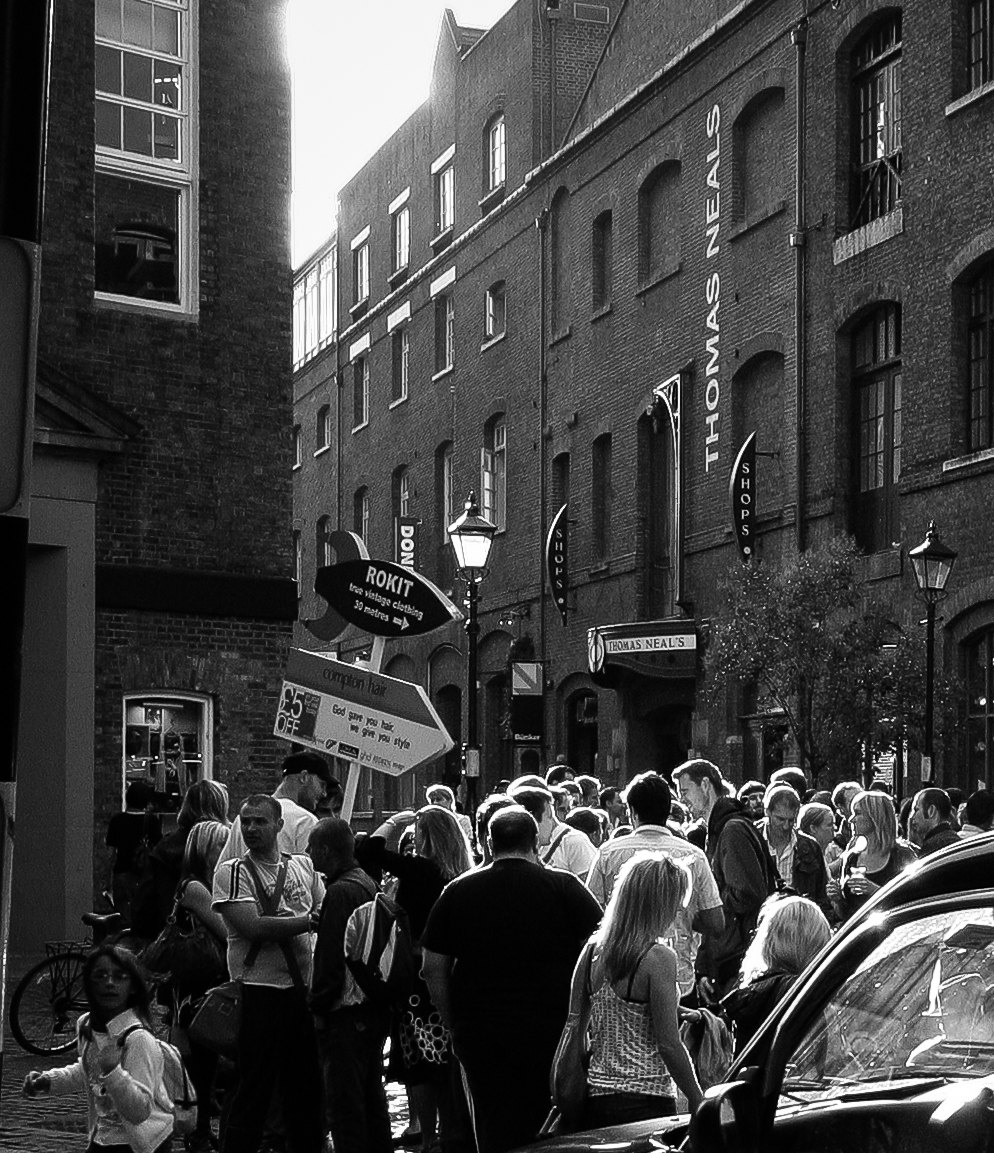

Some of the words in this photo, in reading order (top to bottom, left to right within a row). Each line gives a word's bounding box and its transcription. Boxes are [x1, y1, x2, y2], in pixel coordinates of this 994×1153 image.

[705, 103, 720, 259] NEALS
[705, 272, 720, 472] THOMAS
[740, 462, 751, 536] SHOPS
[400, 525, 415, 571] DON
[554, 528, 564, 589] SHOPS
[365, 565, 414, 598] ROKIT
[363, 606, 389, 622] metres
[364, 588, 392, 607] vintage
[392, 600, 424, 621] clothing
[609, 640, 643, 652] THOMAS
[645, 636, 685, 650] NEAL'S
[323, 669, 365, 691] compton
[367, 677, 387, 698] hair
[276, 714, 300, 736] OFF
[332, 704, 347, 717] God
[347, 711, 364, 723] gave
[366, 717, 379, 727] you
[350, 723, 360, 734] we
[361, 726, 376, 738] give
[378, 733, 391, 743] you
[393, 736, 411, 750] style
